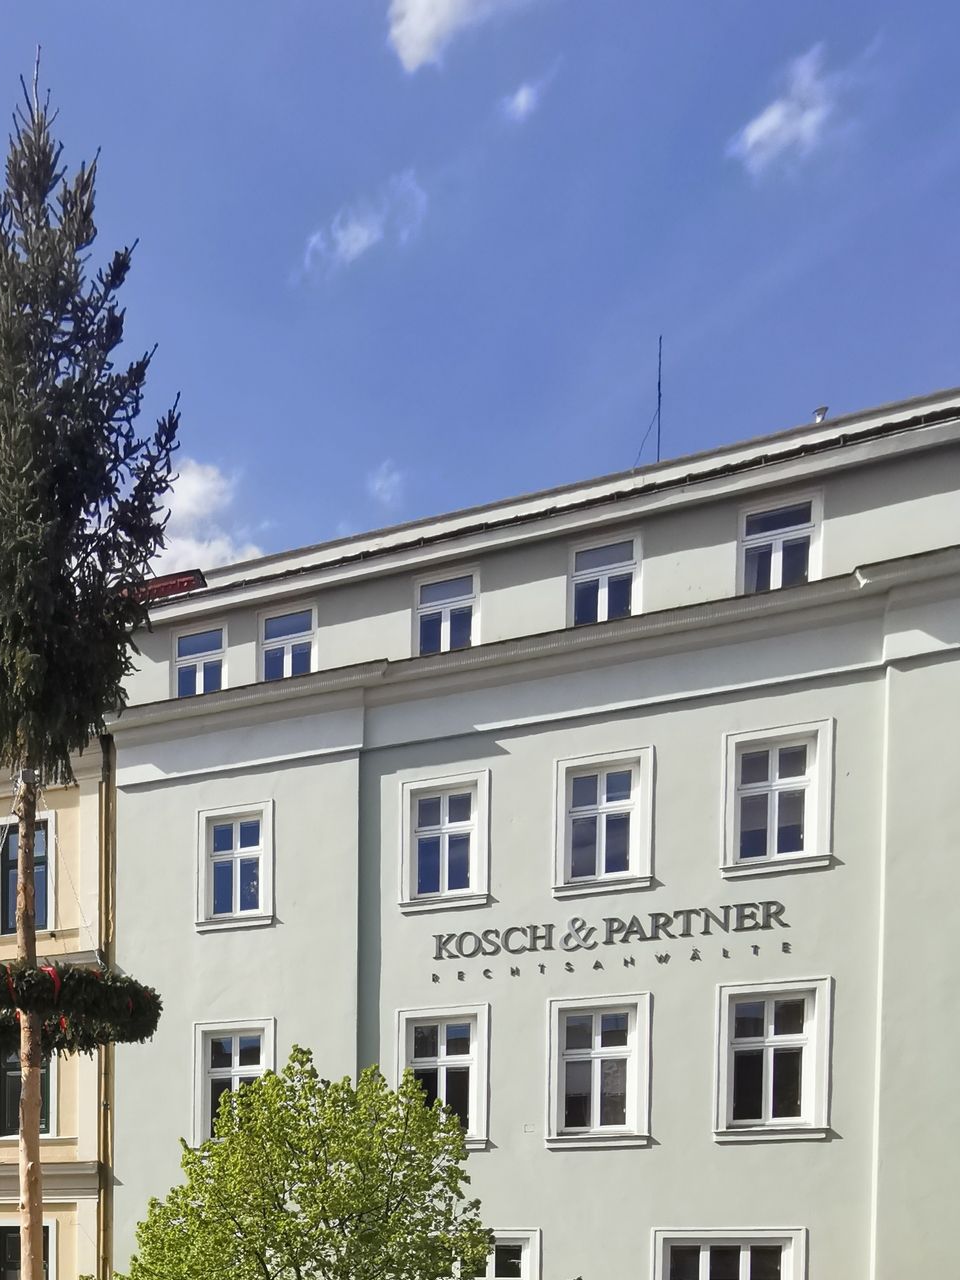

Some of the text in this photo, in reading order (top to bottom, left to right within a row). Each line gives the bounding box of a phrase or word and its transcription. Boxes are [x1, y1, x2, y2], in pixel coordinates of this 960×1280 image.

[432, 900, 791, 961] KOSCH & PARTNER
